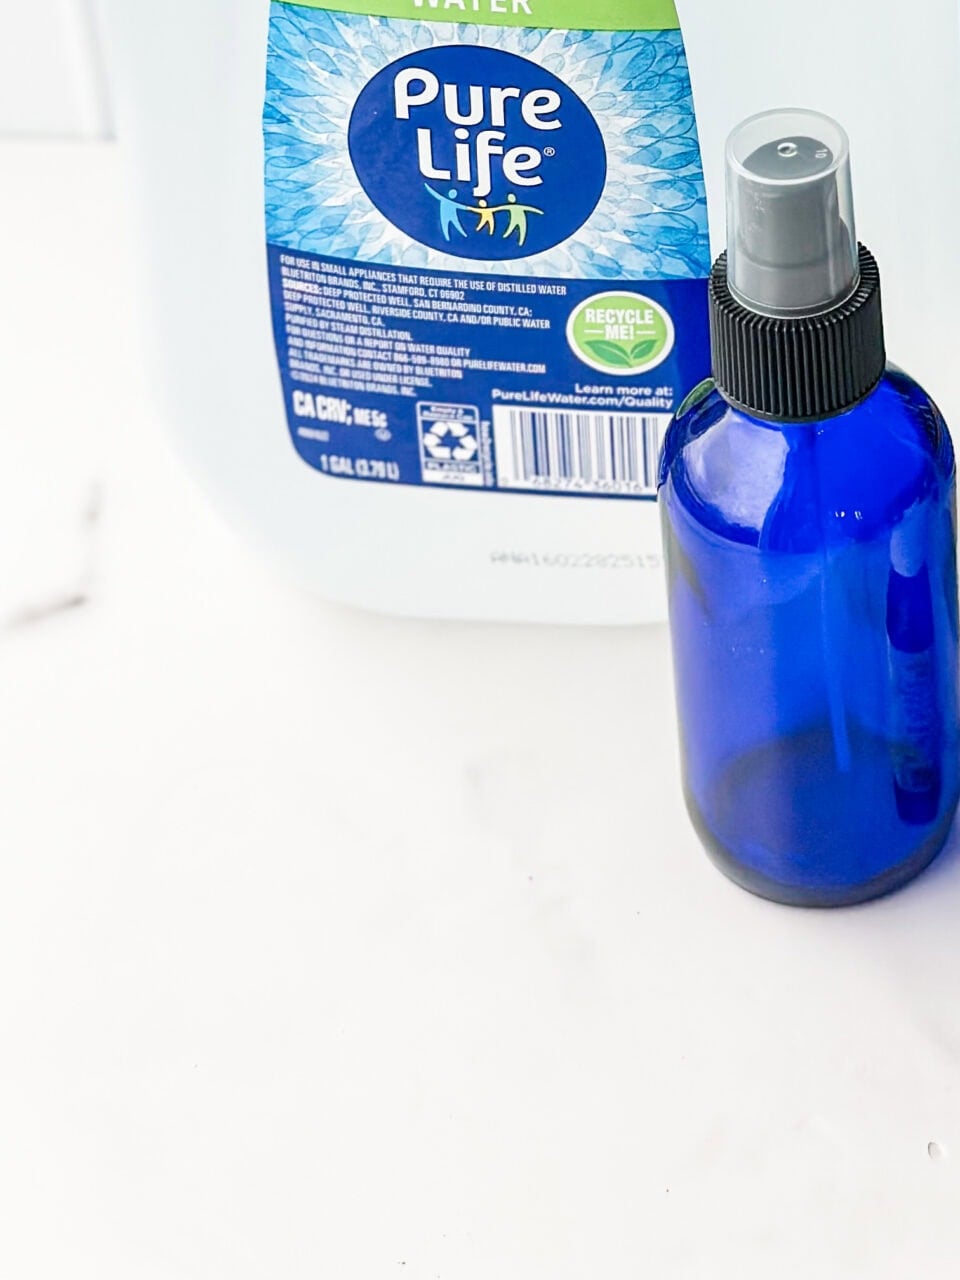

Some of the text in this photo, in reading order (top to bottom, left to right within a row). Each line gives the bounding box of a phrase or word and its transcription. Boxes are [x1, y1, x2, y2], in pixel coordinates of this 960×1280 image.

[393, 67, 563, 130] Pure
[280, 254, 567, 296] FOR USE IN SMALL APPLIANCES THAT REQUIRE THE USE OF DISTILLED WATER
[323, 286, 342, 297] DEEP
[343, 288, 387, 304] PROTECTED
[413, 299, 430, 310] SAN
[431, 300, 482, 312] BERNARDINO
[429, 288, 438, 298] CT
[372, 305, 411, 318] RIVERSIDE
[447, 313, 459, 323] CA
[460, 314, 492, 326] AND/OR
[493, 317, 520, 327] PUBLIC
[522, 319, 551, 329] WATER
[585, 308, 654, 324] RECYCLE
[605, 325, 634, 340] ME!
[407, 342, 436, 354] WATER
[436, 345, 471, 357] QUALITY
[463, 359, 547, 375] PURELIFEWATER.COM
[491, 388, 673, 409] PureLifeWater.com/Quality
[575, 383, 673, 396] Learn more at:
[292, 390, 315, 418] CA
[353, 407, 371, 427] ME
[329, 455, 353, 475] GAL
